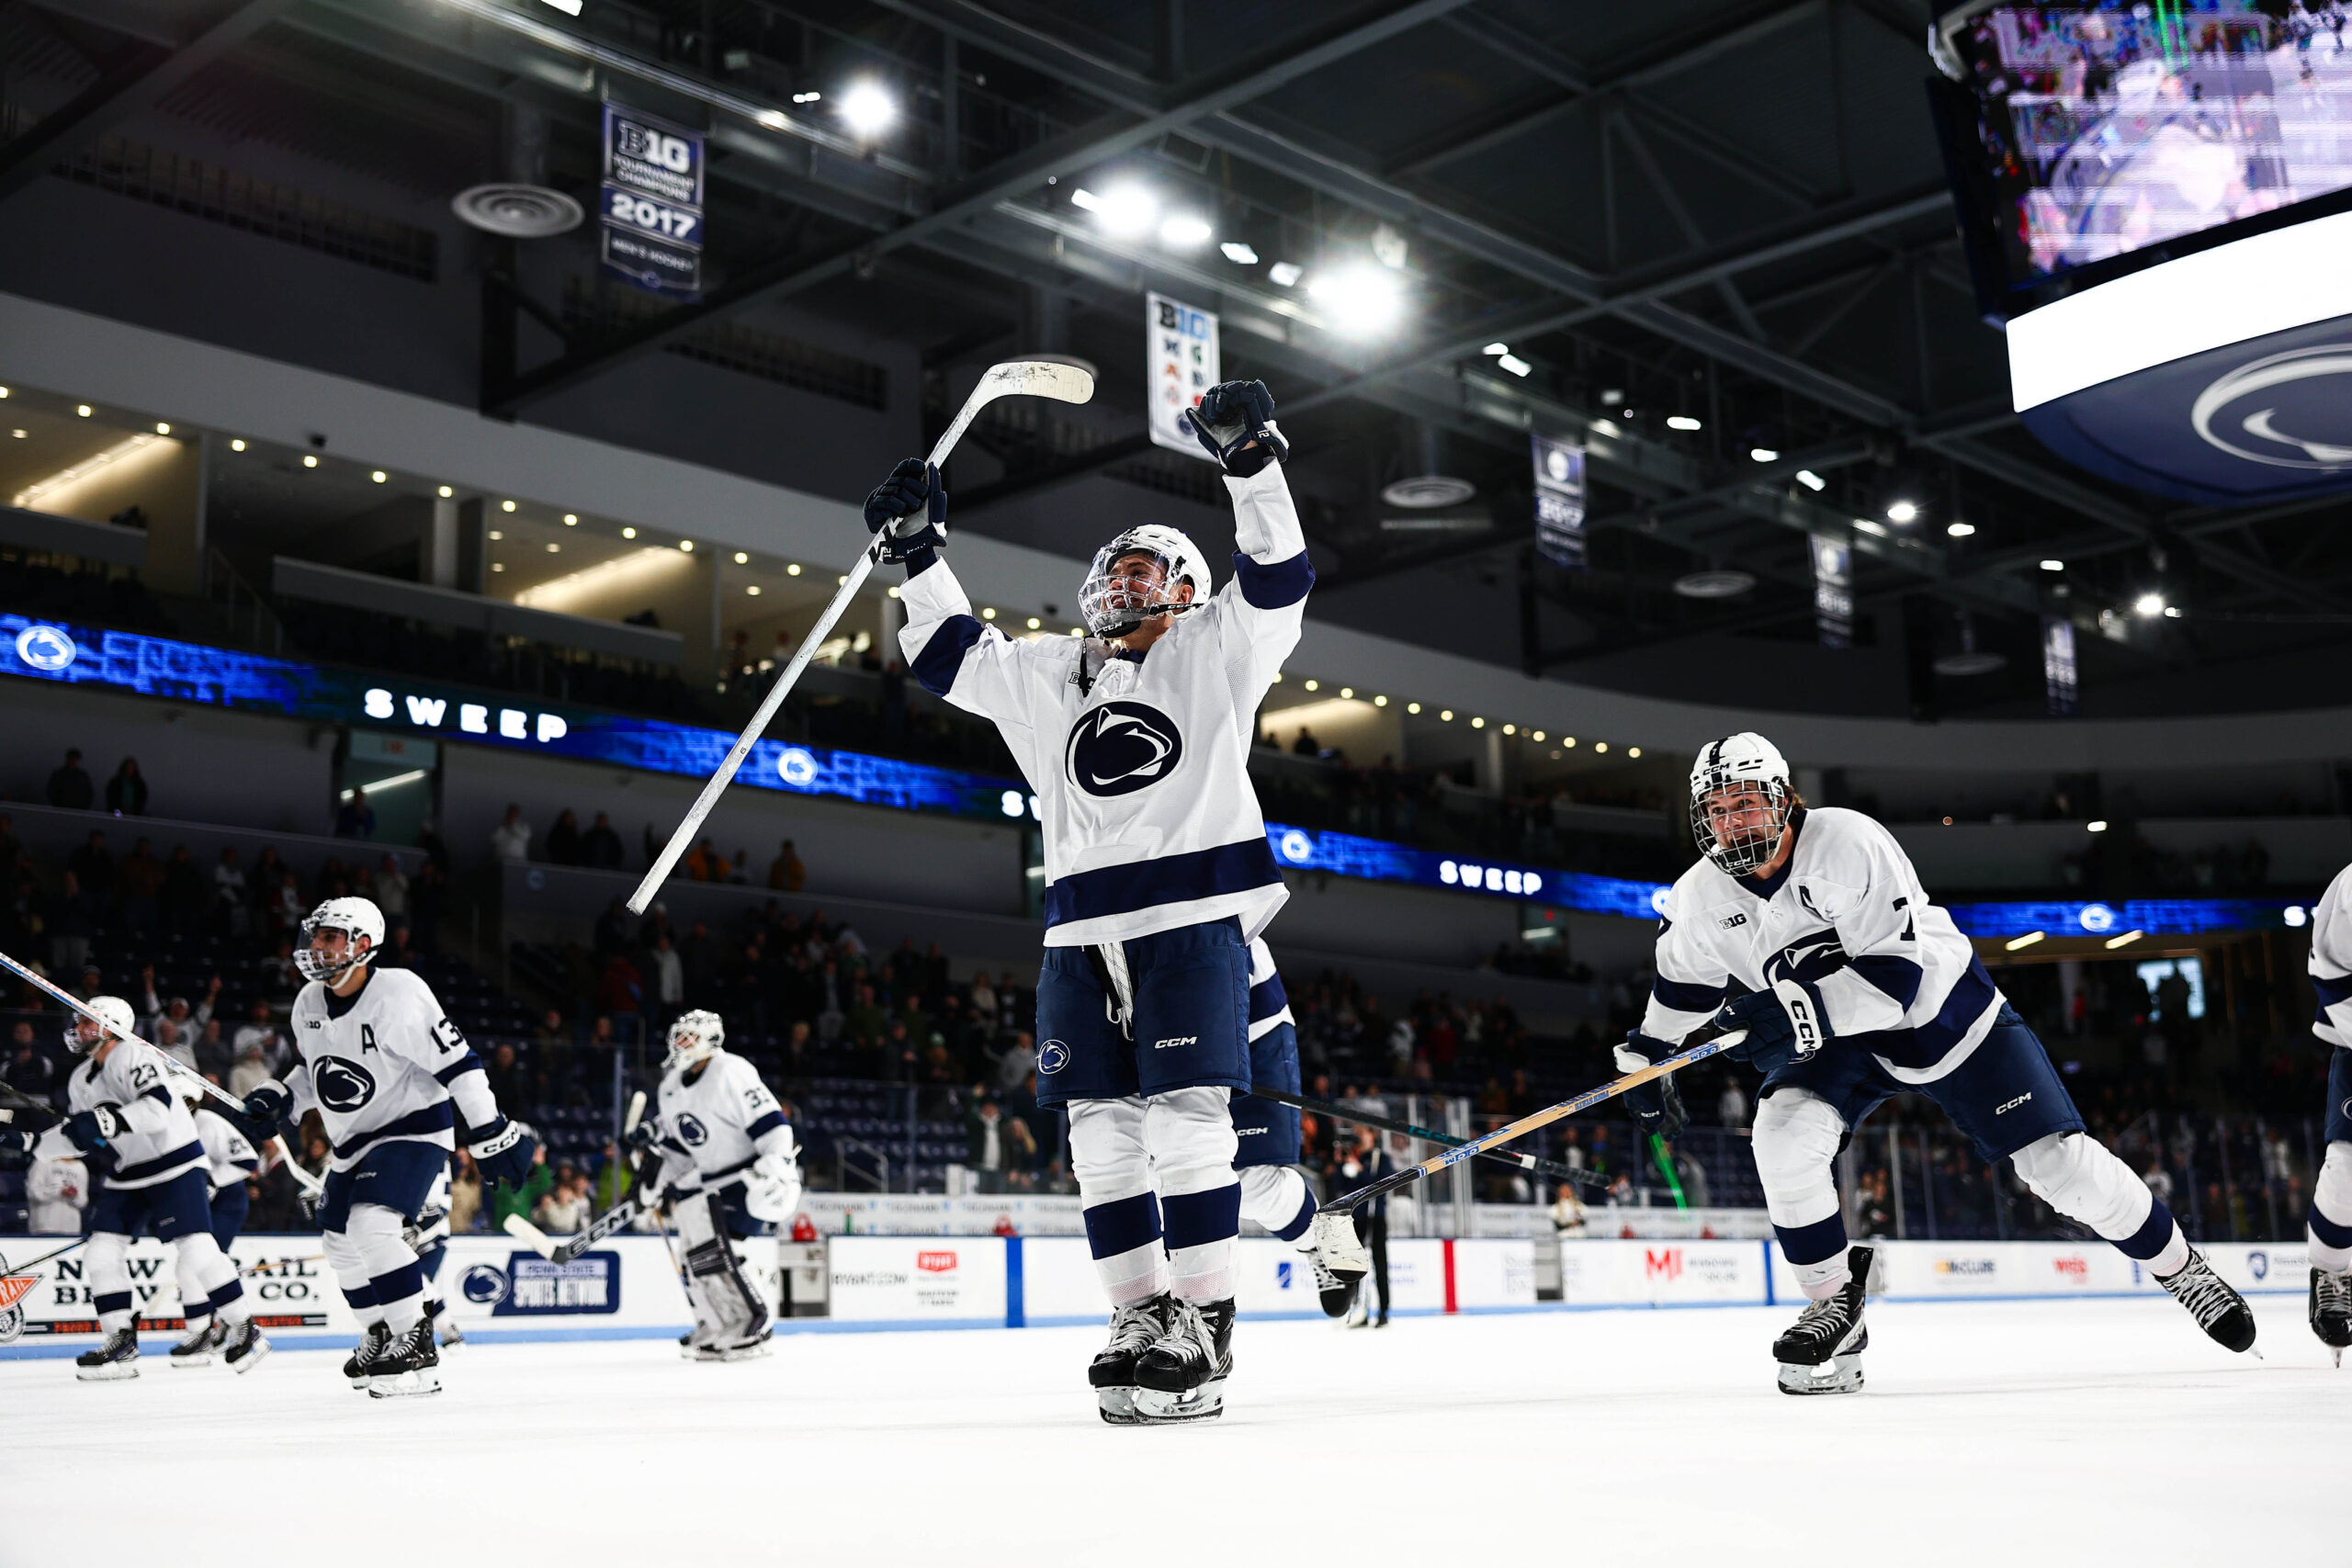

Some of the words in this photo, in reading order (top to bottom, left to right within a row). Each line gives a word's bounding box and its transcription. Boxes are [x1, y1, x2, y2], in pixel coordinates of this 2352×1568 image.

[611, 193, 696, 238] 2017
[1102, 622, 1123, 632] CCM
[364, 688, 568, 743] SWEEP
[1713, 748, 1717, 756] 7
[1702, 762, 1730, 775] CCM
[1439, 859, 1543, 896] SWEEP
[1892, 897, 1917, 942] 7
[431, 1017, 465, 1055] 13
[1791, 999, 1816, 1052] CCM
[361, 1023, 379, 1055] A
[1155, 1036, 1198, 1049] CCM
[130, 1064, 158, 1089] 23
[1995, 1091, 2032, 1116] CCM
[1237, 1126, 1269, 1136] CCM
[570, 1206, 628, 1255] CCM
[54, 1259, 164, 1280] NW
[259, 1282, 320, 1302] CO.
